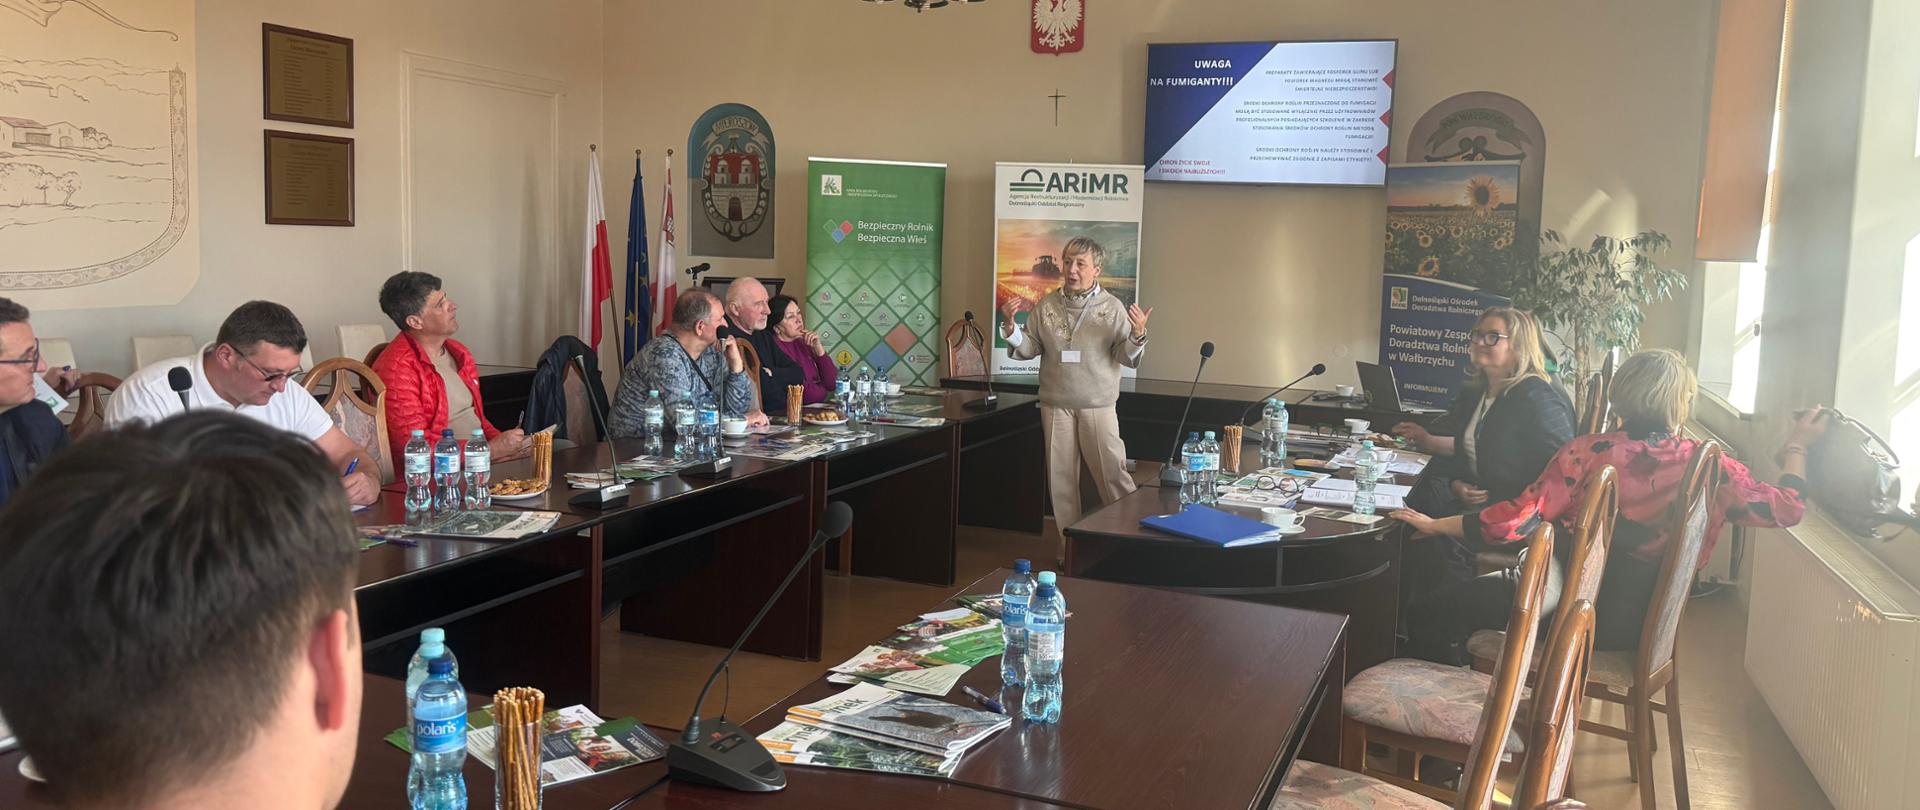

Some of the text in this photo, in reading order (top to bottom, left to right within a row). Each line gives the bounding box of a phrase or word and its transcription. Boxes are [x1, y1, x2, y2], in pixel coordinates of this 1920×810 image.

[1194, 60, 1231, 68] UWAGA
[1166, 77, 1233, 86] FUMIGANTY!!!
[1046, 172, 1128, 193] ARiMR
[858, 221, 934, 232] Bezpieczny Rolnik
[858, 233, 927, 244] Bezpieczna Wieś
[1450, 298, 1478, 306] Ośrodek
[1412, 304, 1447, 312] Doradztwa
[1448, 306, 1483, 316] Rolniczego
[1390, 324, 1472, 341] Powiatowy Zespó
[1389, 338, 1472, 354] Doradztwa Rolnic
[1399, 352, 1455, 367] Wałbrzychu
[1404, 383, 1448, 393] INFORMUJEMY
[417, 721, 457, 736] polaris
